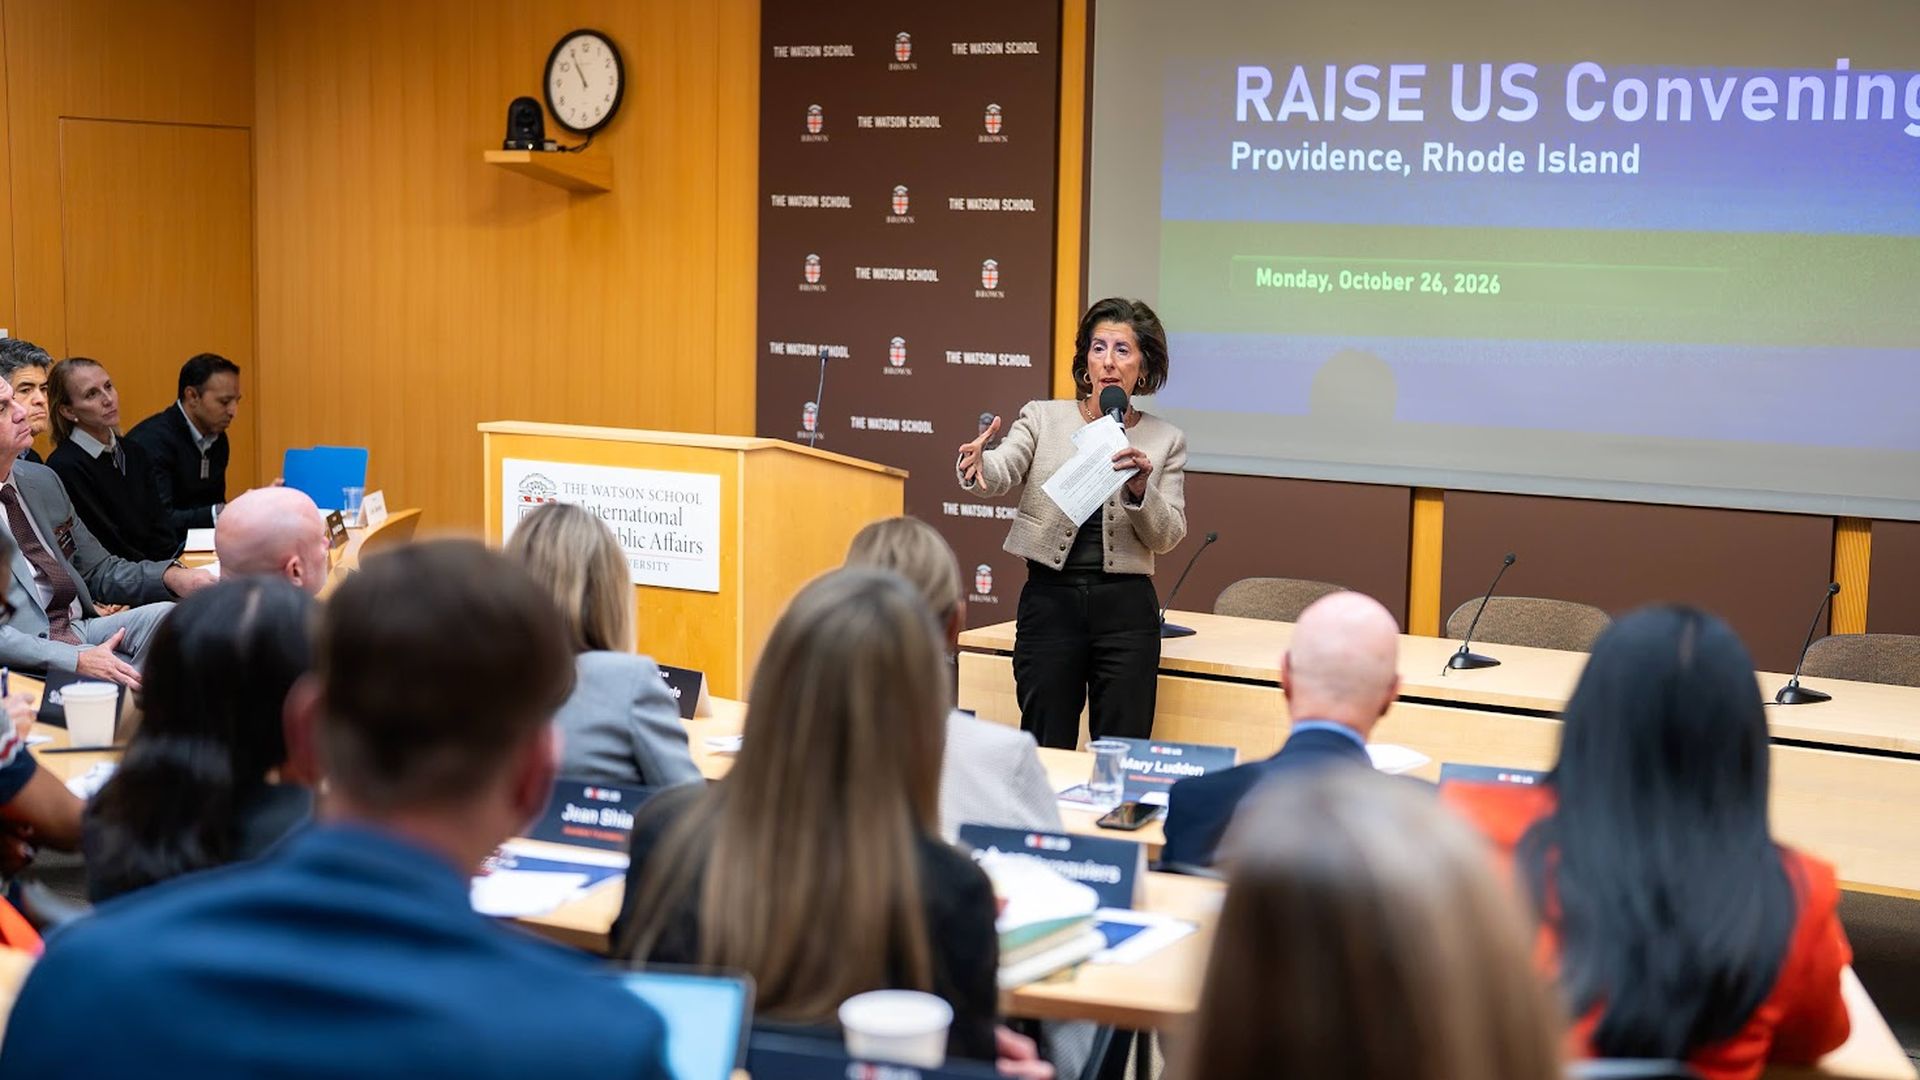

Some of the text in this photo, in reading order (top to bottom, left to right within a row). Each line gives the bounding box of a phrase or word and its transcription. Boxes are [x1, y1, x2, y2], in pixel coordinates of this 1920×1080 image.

[774, 45, 854, 57] THE WATSON SCHOOL
[952, 42, 1039, 55] THE WATSON SCHOOL
[1236, 64, 1427, 122] RAISE
[1451, 62, 1540, 122] US
[857, 116, 941, 128] THE WATSON SCHOOL
[1231, 141, 1640, 177] Providence, Rhode Island
[772, 195, 852, 208] THE WATSON SCHOOL
[949, 198, 1035, 211] THE WATSON SCHOOL
[856, 267, 939, 282] THE WATSON SCHOOL
[1256, 267, 1501, 295] Monday, October 26, 2026
[770, 342, 784, 354] THE
[786, 343, 817, 356] WATSON
[946, 351, 1032, 367] THE WATSON SCHOOL
[851, 416, 934, 433] THE WATSON SCHOOL
[562, 482, 703, 505] THE WATSON SCHOOL
[943, 502, 959, 515] THE
[960, 504, 994, 518] WATSON
[613, 526, 704, 555] blic Affairs
[1119, 757, 1205, 777] Mary Ludden
